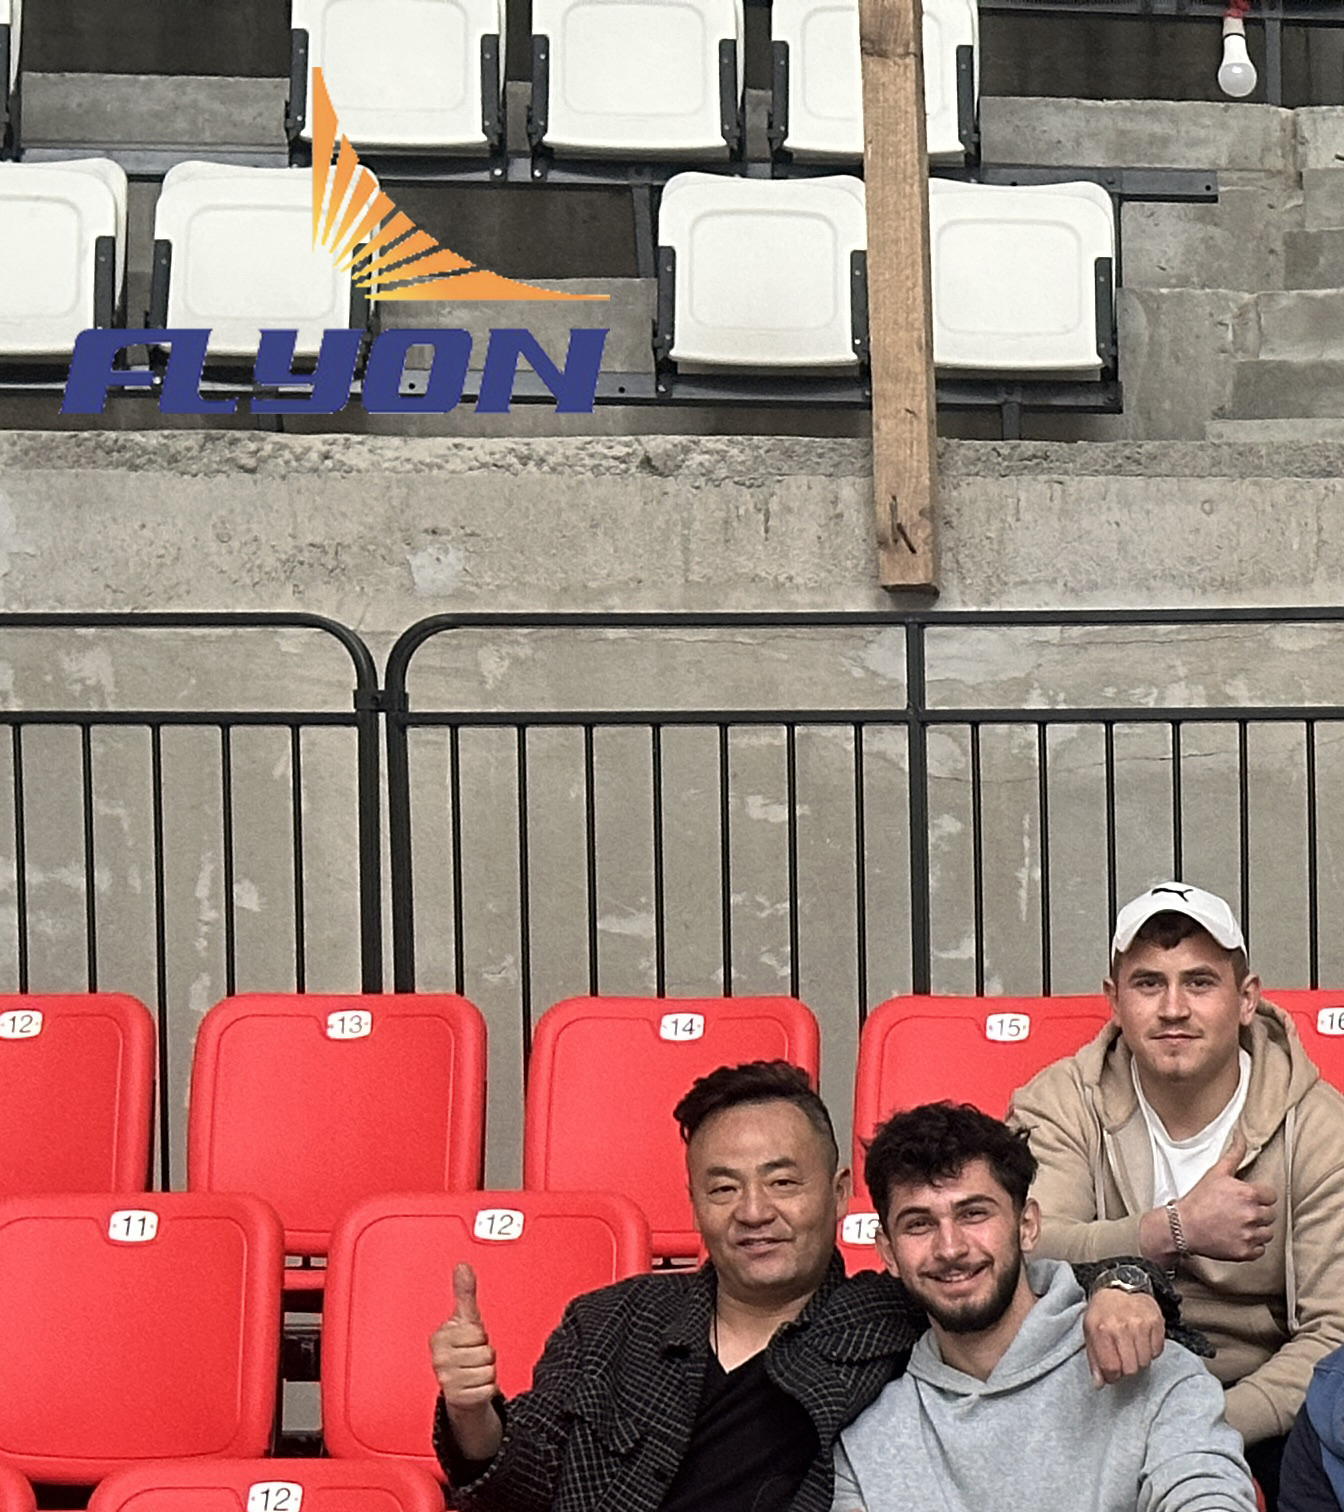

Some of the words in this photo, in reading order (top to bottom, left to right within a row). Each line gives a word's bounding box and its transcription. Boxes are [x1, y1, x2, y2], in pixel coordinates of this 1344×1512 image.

[9, 1014, 34, 1034] 12
[337, 1015, 363, 1034] 13
[671, 1018, 696, 1036] 14
[997, 1018, 1021, 1037] 15
[123, 1215, 146, 1237] 11
[487, 1214, 514, 1236] 12
[855, 1218, 880, 1240] 13
[260, 1487, 291, 1512] 12
